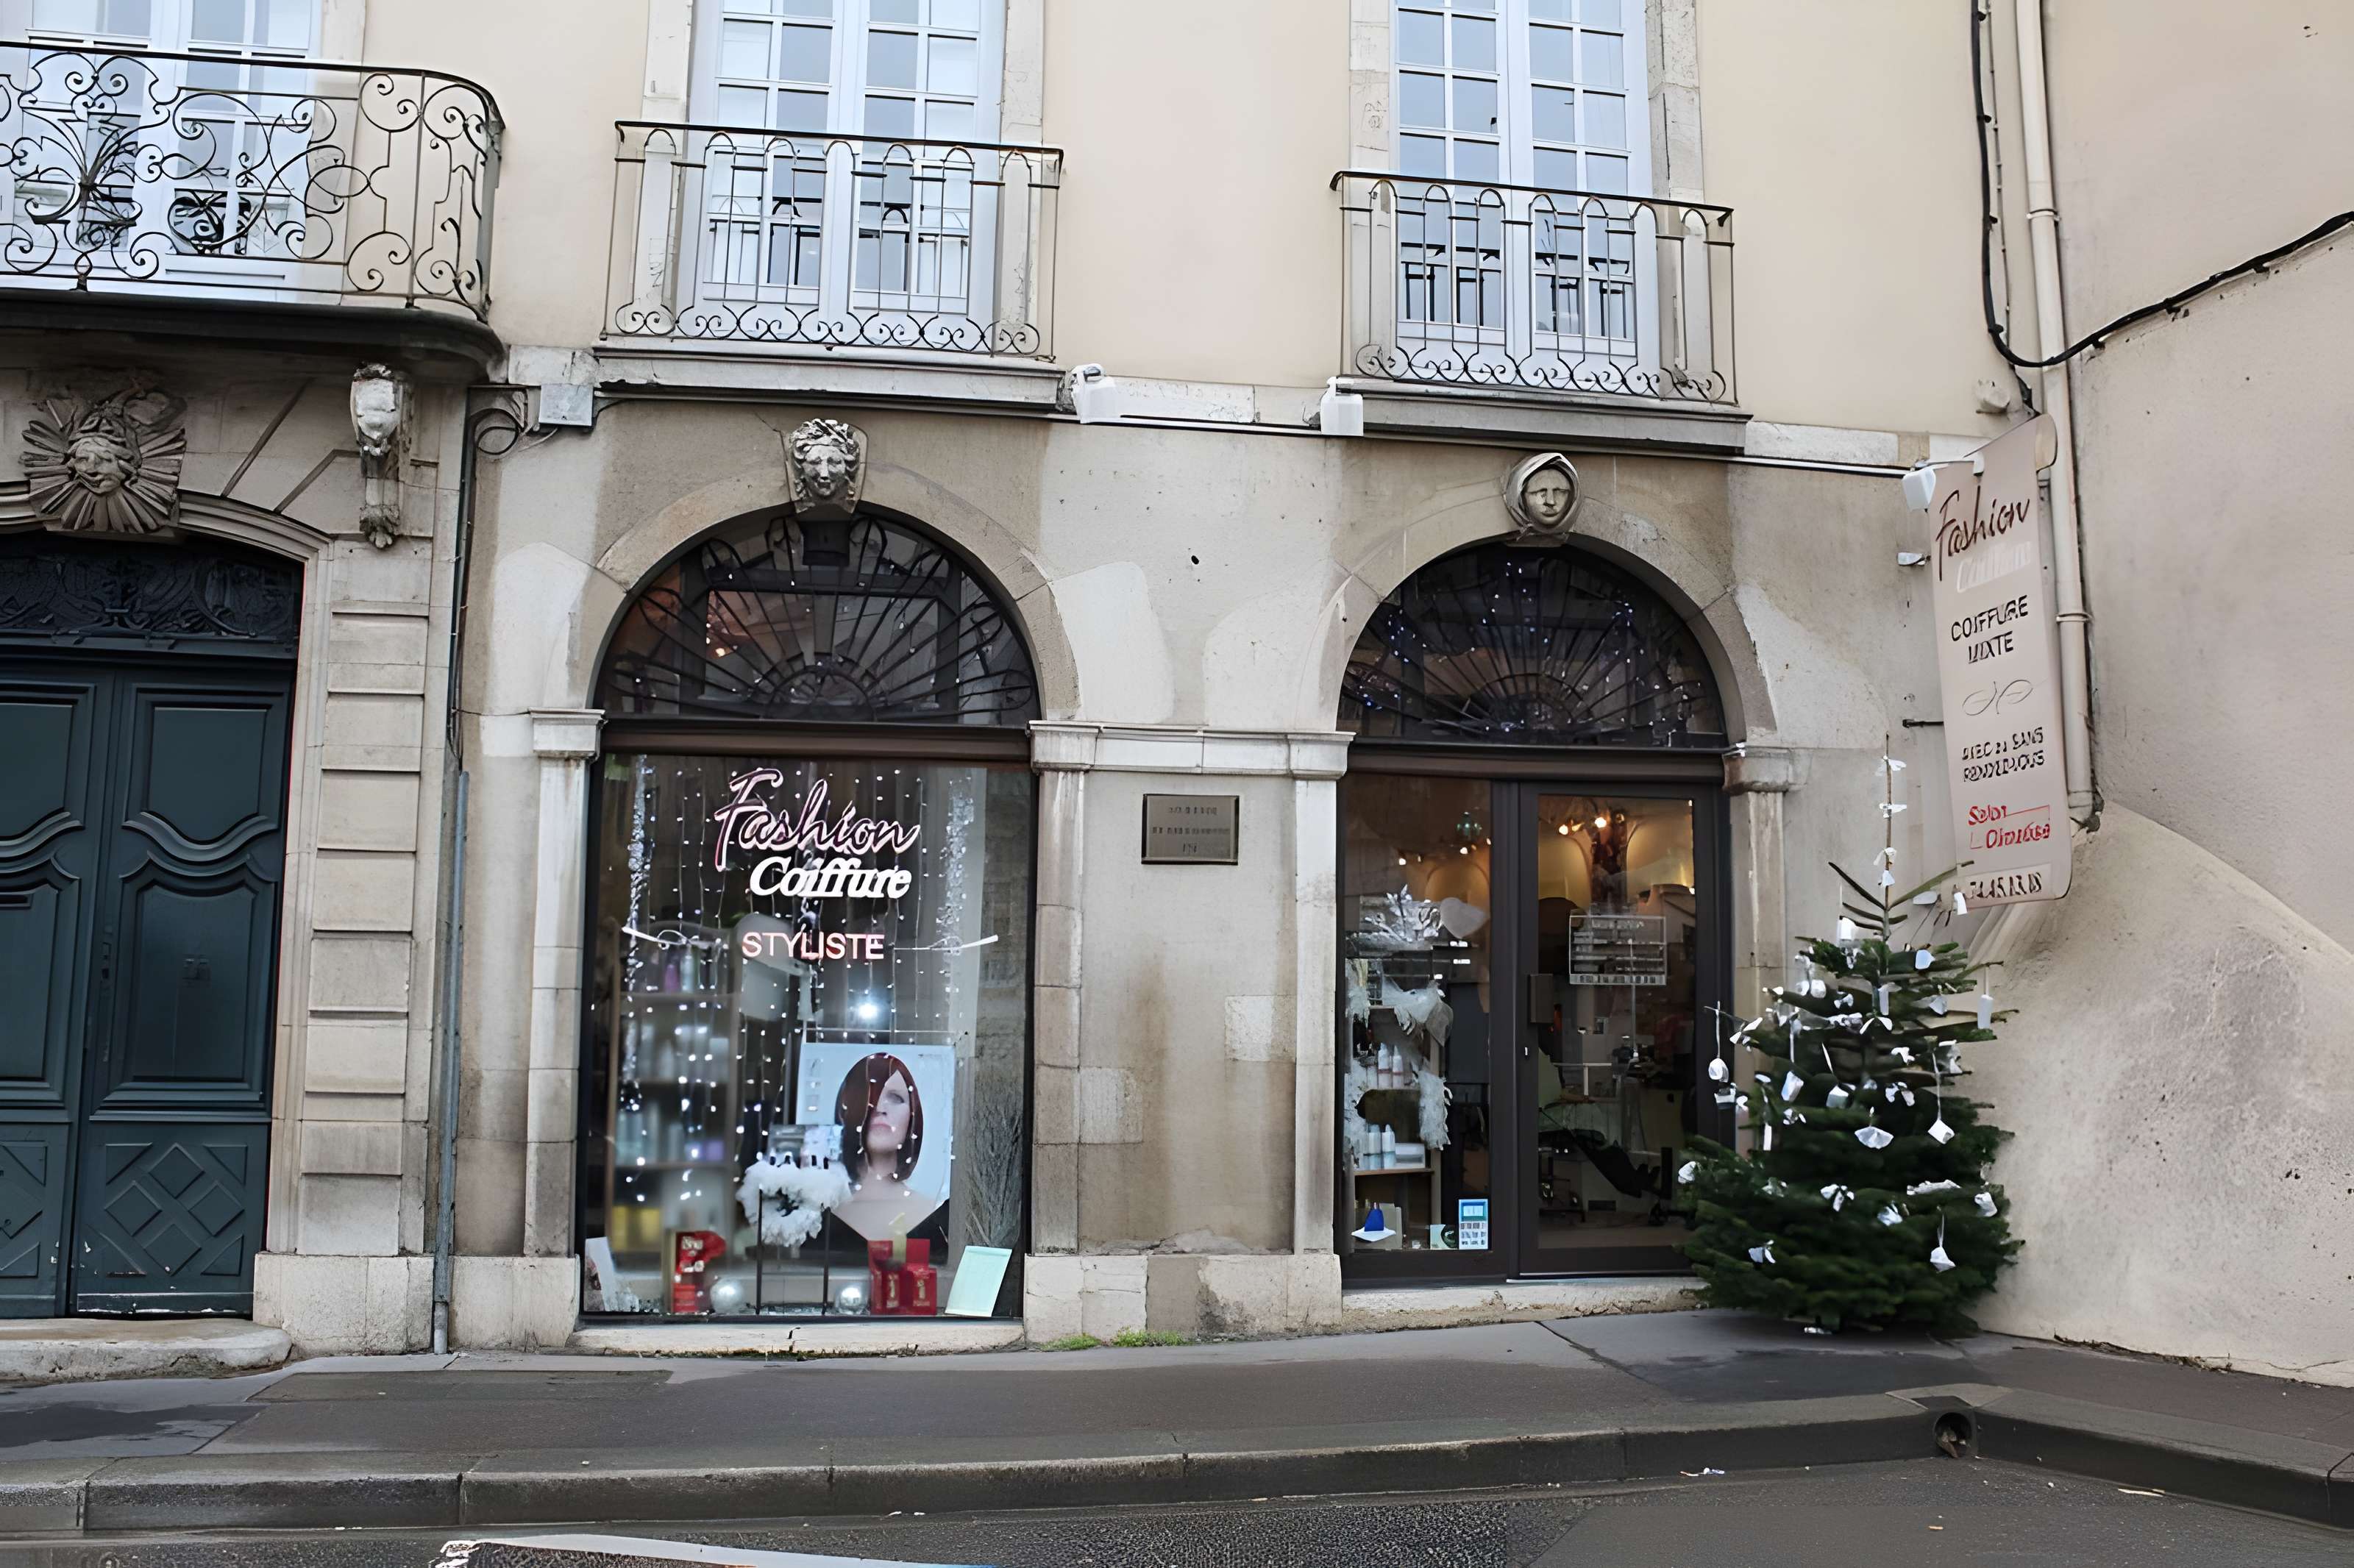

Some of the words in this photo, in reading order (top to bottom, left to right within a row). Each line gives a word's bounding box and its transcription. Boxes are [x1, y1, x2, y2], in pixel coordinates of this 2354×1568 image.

[1935, 484, 2030, 582] Fashion
[714, 767, 921, 872] Fashion
[749, 856, 912, 899] Coiffure
[742, 932, 886, 959] STYLISTE
